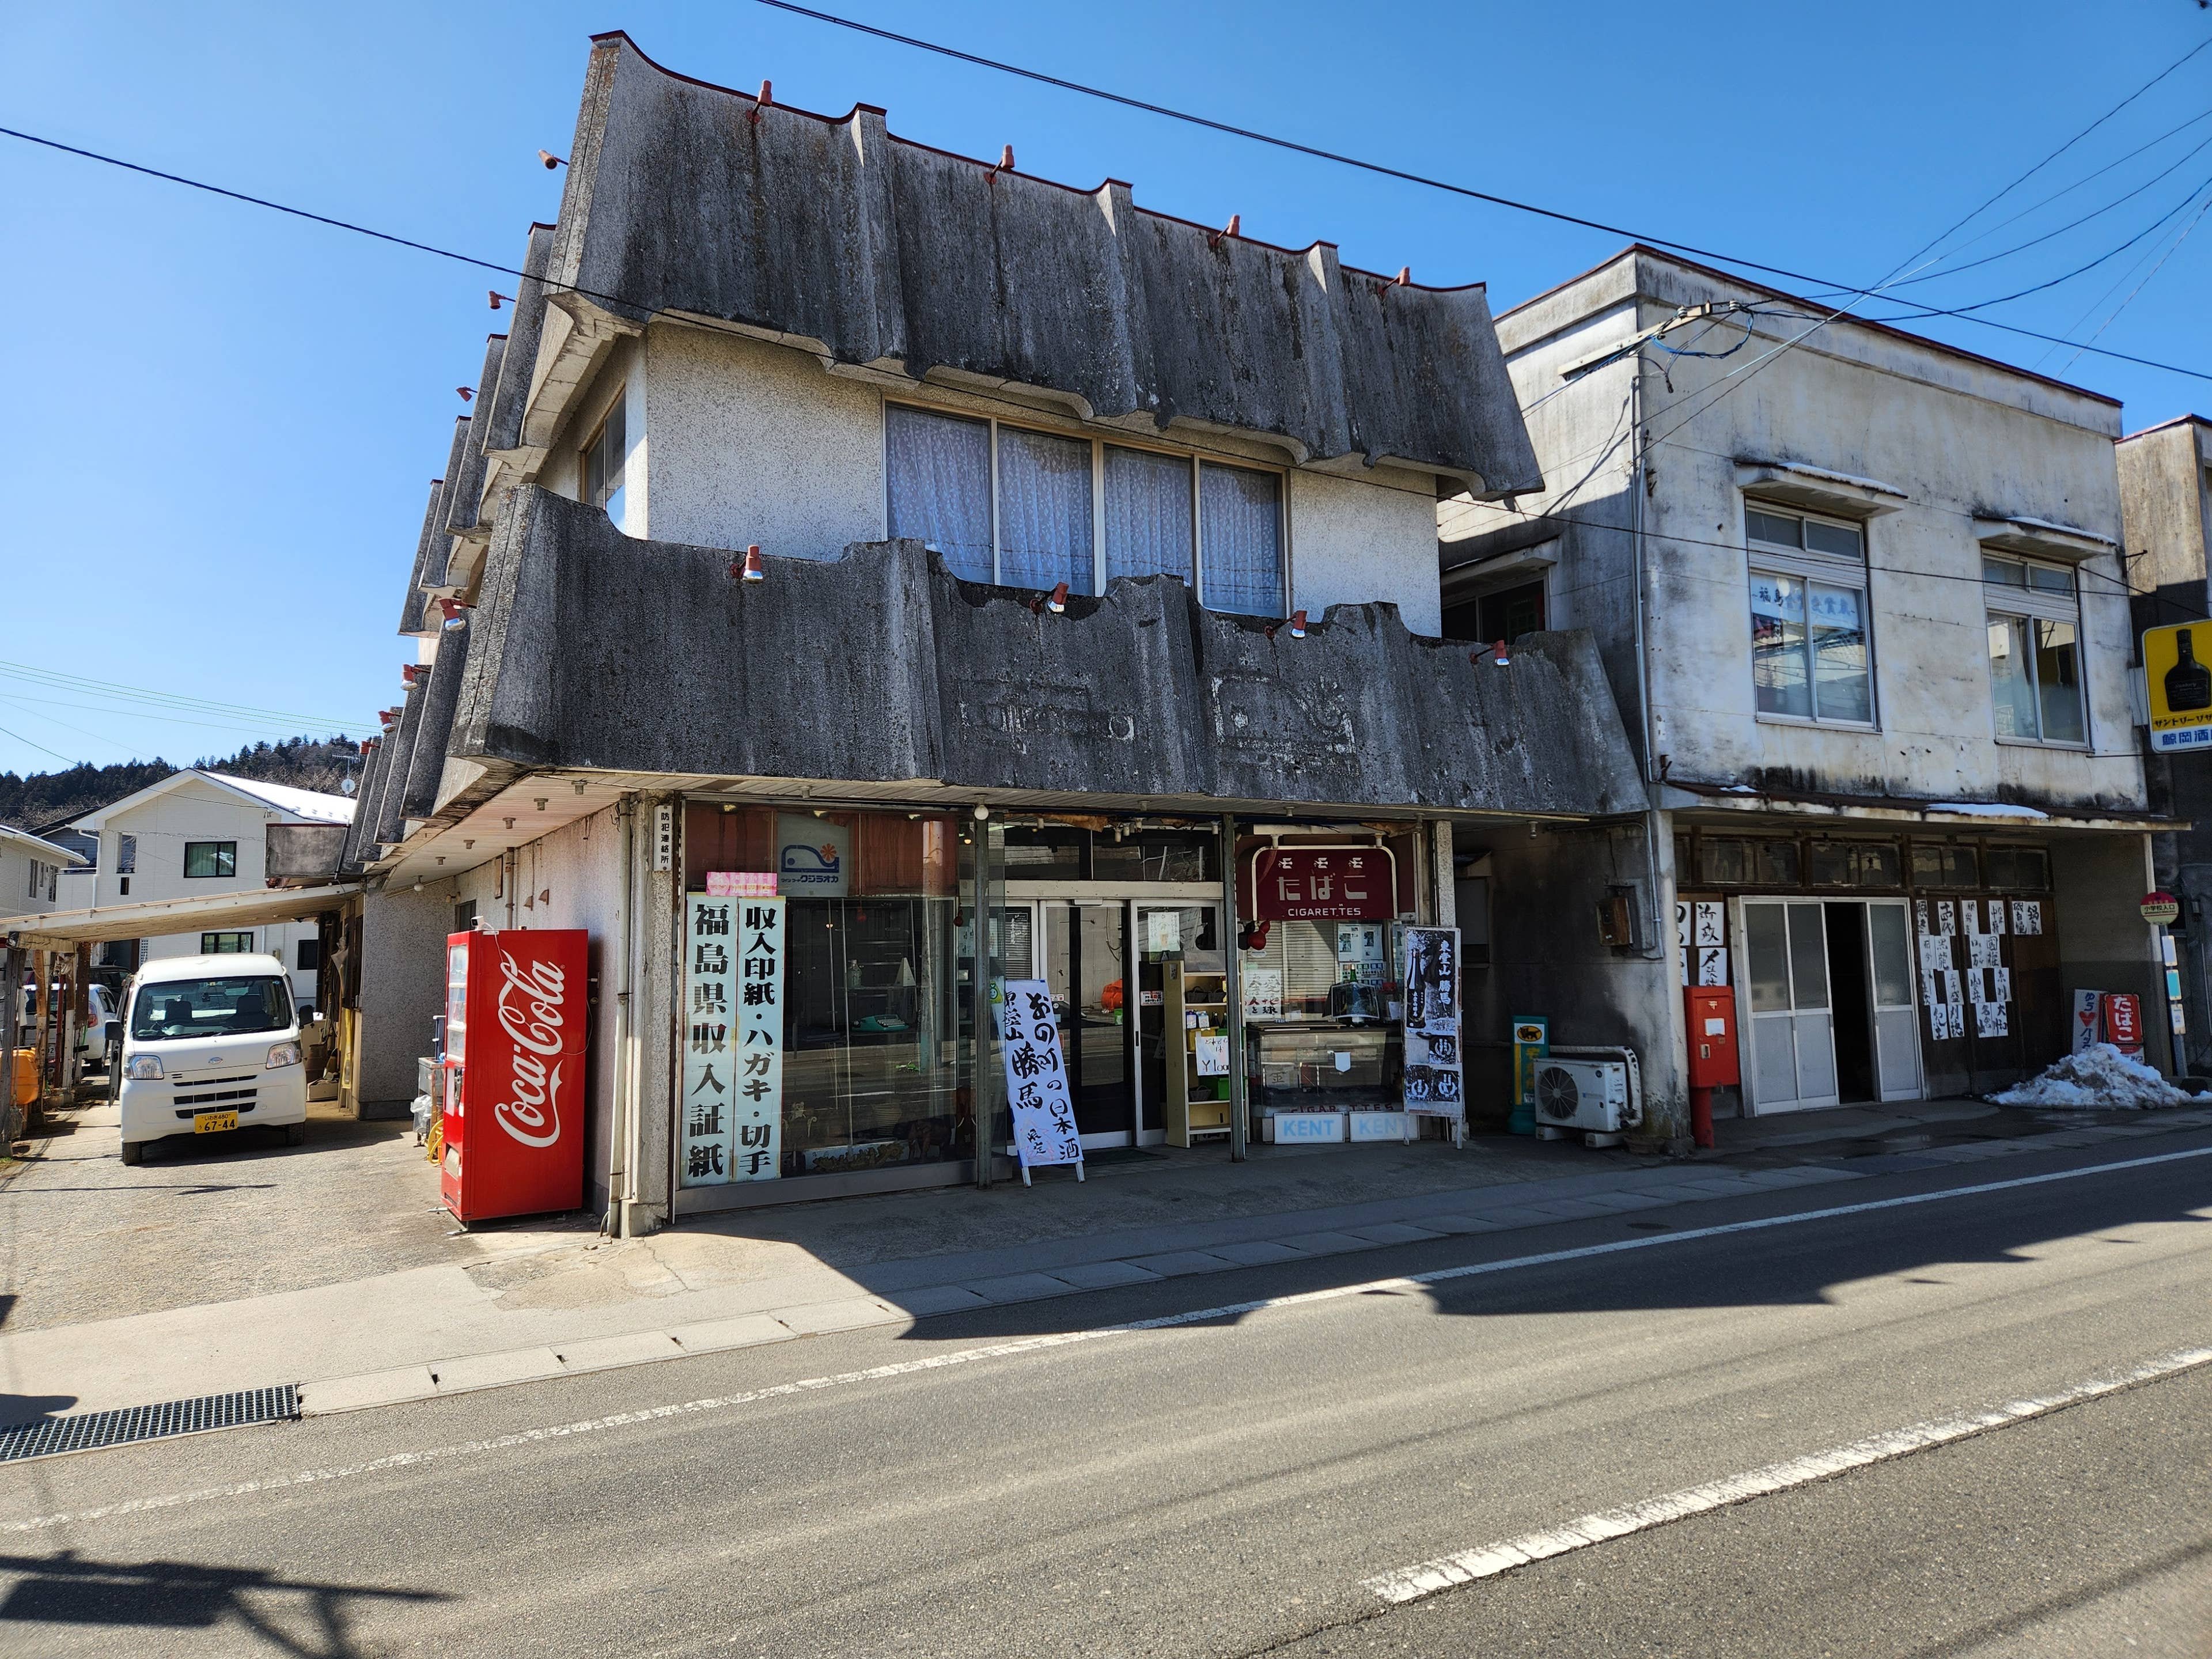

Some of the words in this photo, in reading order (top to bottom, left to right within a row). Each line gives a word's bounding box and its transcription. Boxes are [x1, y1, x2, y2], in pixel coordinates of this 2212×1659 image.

[2162, 729, 2212, 746] 鯨岡酒
[660, 812, 669, 863] 防犯連絡所
[800, 875, 839, 883] クジラオカ
[1277, 872, 1368, 901] たばこ
[1288, 907, 1361, 916] CIGARETTES
[2084, 992, 2096, 1011] ゆう
[2113, 996, 2135, 1042] たばこ
[494, 949, 565, 1147] Coca-Cola
[688, 903, 730, 1178] 福島県収入証紙
[738, 906, 777, 1175] 収入印紙・ハガキ・切手
[1025, 992, 1080, 1160] おの町の日本酒
[204, 1119, 236, 1131] 67-44
[1283, 1120, 1335, 1137] KENT
